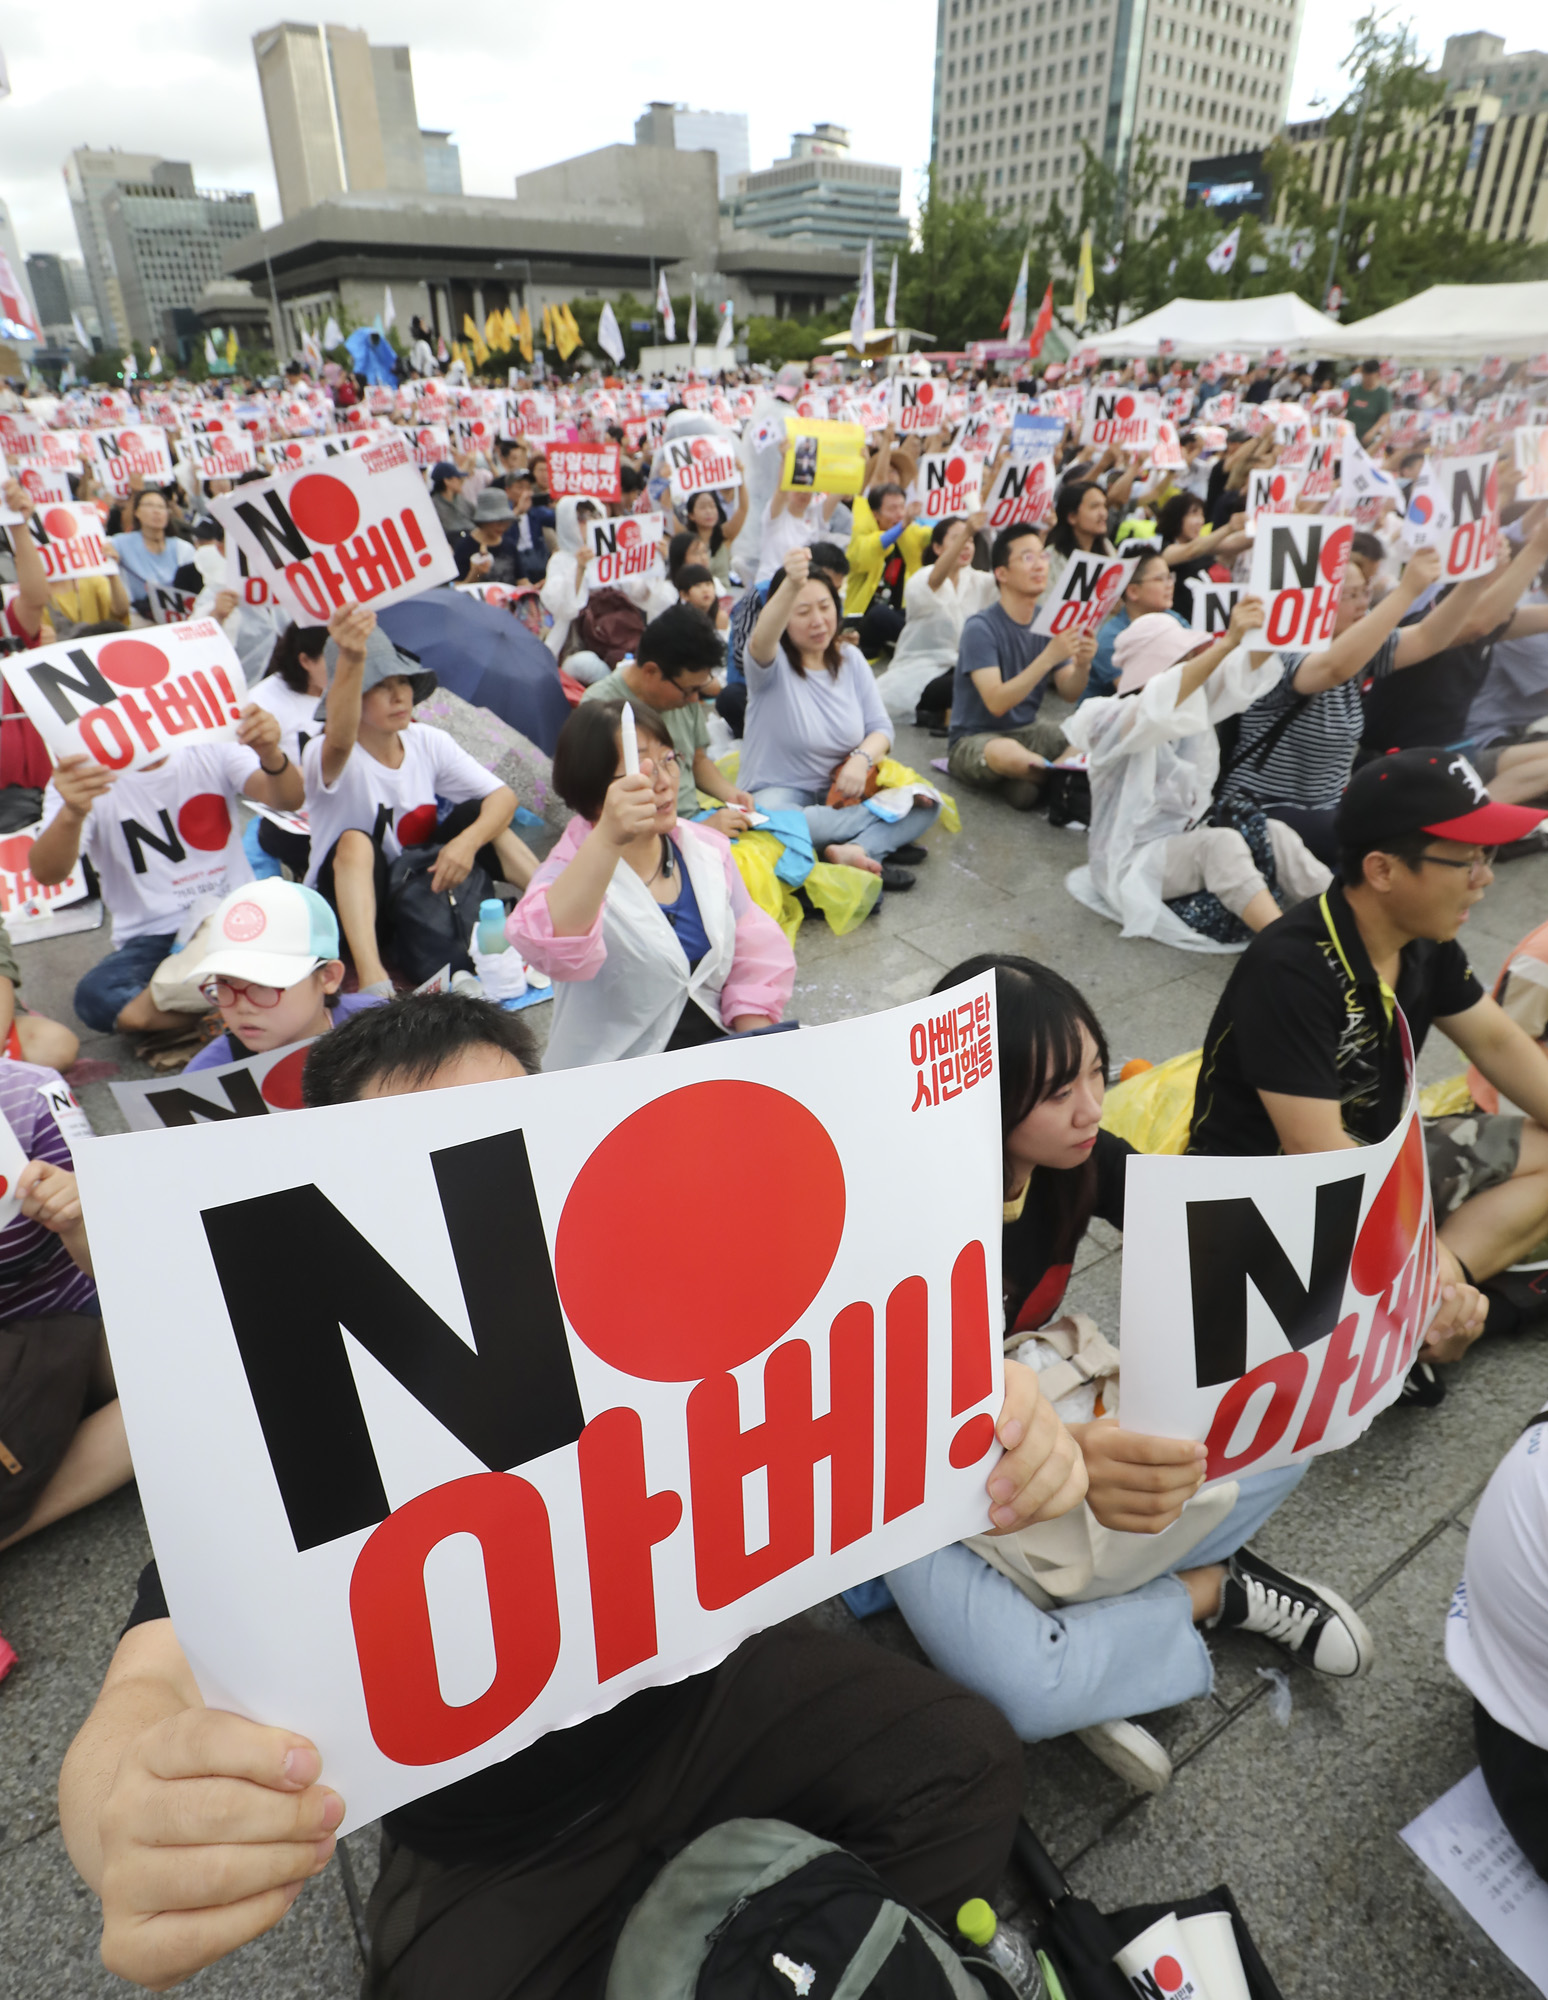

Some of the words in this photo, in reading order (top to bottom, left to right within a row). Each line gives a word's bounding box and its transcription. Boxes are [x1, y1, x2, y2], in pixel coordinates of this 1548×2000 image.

[506, 399, 538, 419] NO
[901, 383, 934, 407] NO
[1096, 396, 1135, 419] NO
[459, 421, 485, 438] NO
[902, 404, 943, 429] 아베!
[965, 418, 990, 438] NO
[98, 431, 143, 459] NO
[194, 435, 234, 457] NO
[272, 444, 302, 463] NO
[671, 438, 716, 468] NO
[109, 450, 164, 480] 아베!
[203, 452, 250, 476] 아베!
[551, 471, 618, 494] 청산하자
[678, 456, 733, 490] 아베!
[927, 457, 966, 490] NO
[999, 461, 1046, 498] NO
[1255, 475, 1286, 505] NO
[234, 473, 360, 571] NO
[595, 520, 641, 557] NO
[285, 507, 433, 621] 아베!
[597, 541, 656, 583] 아베!
[1270, 524, 1355, 591] NO
[1062, 561, 1124, 602] NO
[26, 639, 171, 725] NO
[79, 665, 241, 770] 아베!
[120, 793, 232, 874] NO
[910, 992, 991, 1066] 아베규탄
[145, 1045, 306, 1128] NO
[911, 1033, 993, 1113] 시민행동
[1185, 1111, 1425, 1389] NO
[200, 1079, 846, 1552] NO
[348, 1238, 996, 1767] 아베!
[1132, 1955, 1183, 2000] NO
